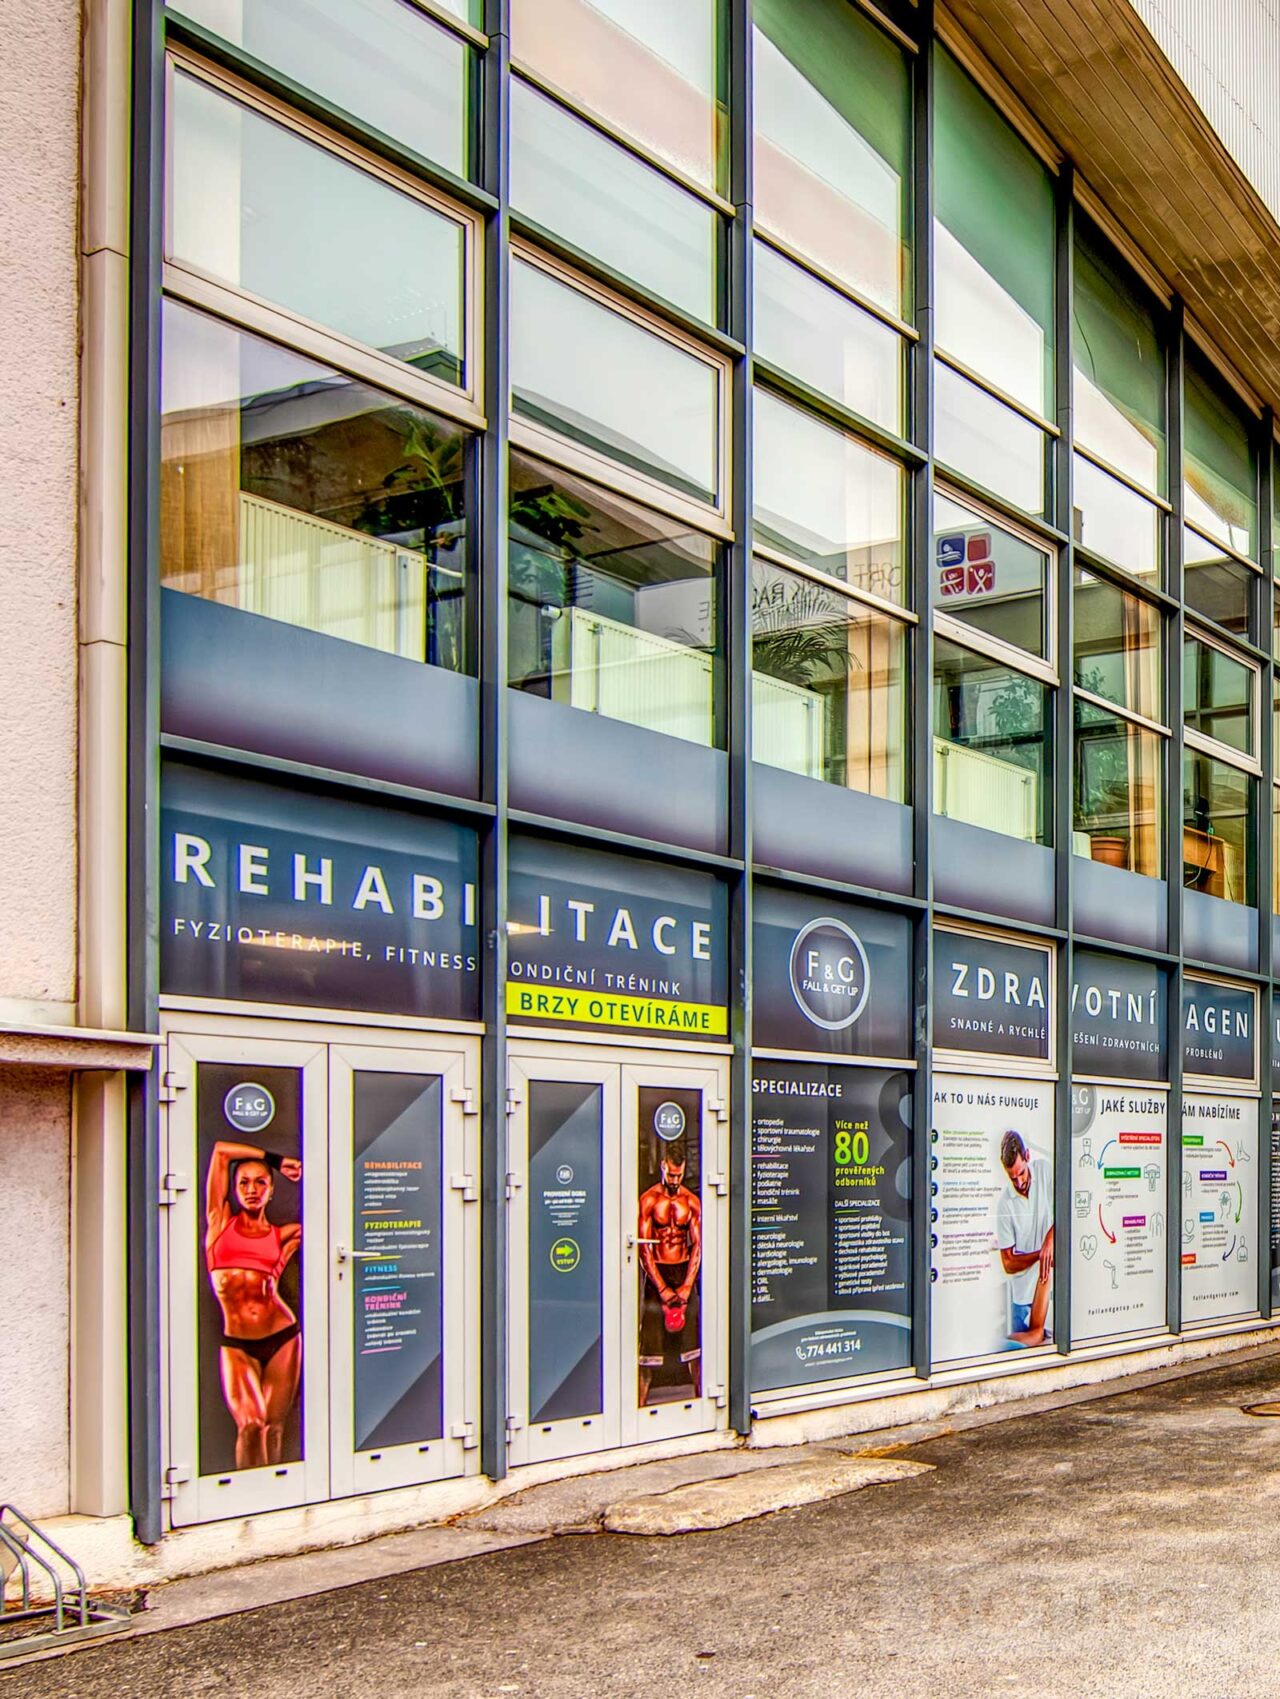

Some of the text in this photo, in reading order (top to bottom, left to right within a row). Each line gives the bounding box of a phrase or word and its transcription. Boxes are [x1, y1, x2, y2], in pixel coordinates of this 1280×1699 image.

[173, 918, 681, 996] FYZIOTERAPIE, FITNESS ONDIČNÍ TRÉNINK
[802, 979, 858, 996] FALL & GET UP
[520, 992, 710, 1029] BRZY OTEVÍRÁME
[950, 1017, 1223, 1061] SNADNÉ A RYCHLÉ EŠENÍ ZDRAVOTNÍCH PROBLÉMŮ
[752, 1079, 842, 1097] SPECIALIZACE
[934, 1092, 1039, 1110] AK TO U NÁS FUNGUJE
[1100, 1096, 1241, 1120] JAKÉ SLUŽBY ÁM NABÍZÍME
[835, 1120, 869, 1130] Více než
[834, 1131, 869, 1165] 80
[835, 1166, 885, 1177] prověřených
[835, 1176, 877, 1187] odborníků
[806, 1339, 861, 1358] 774 441 314
